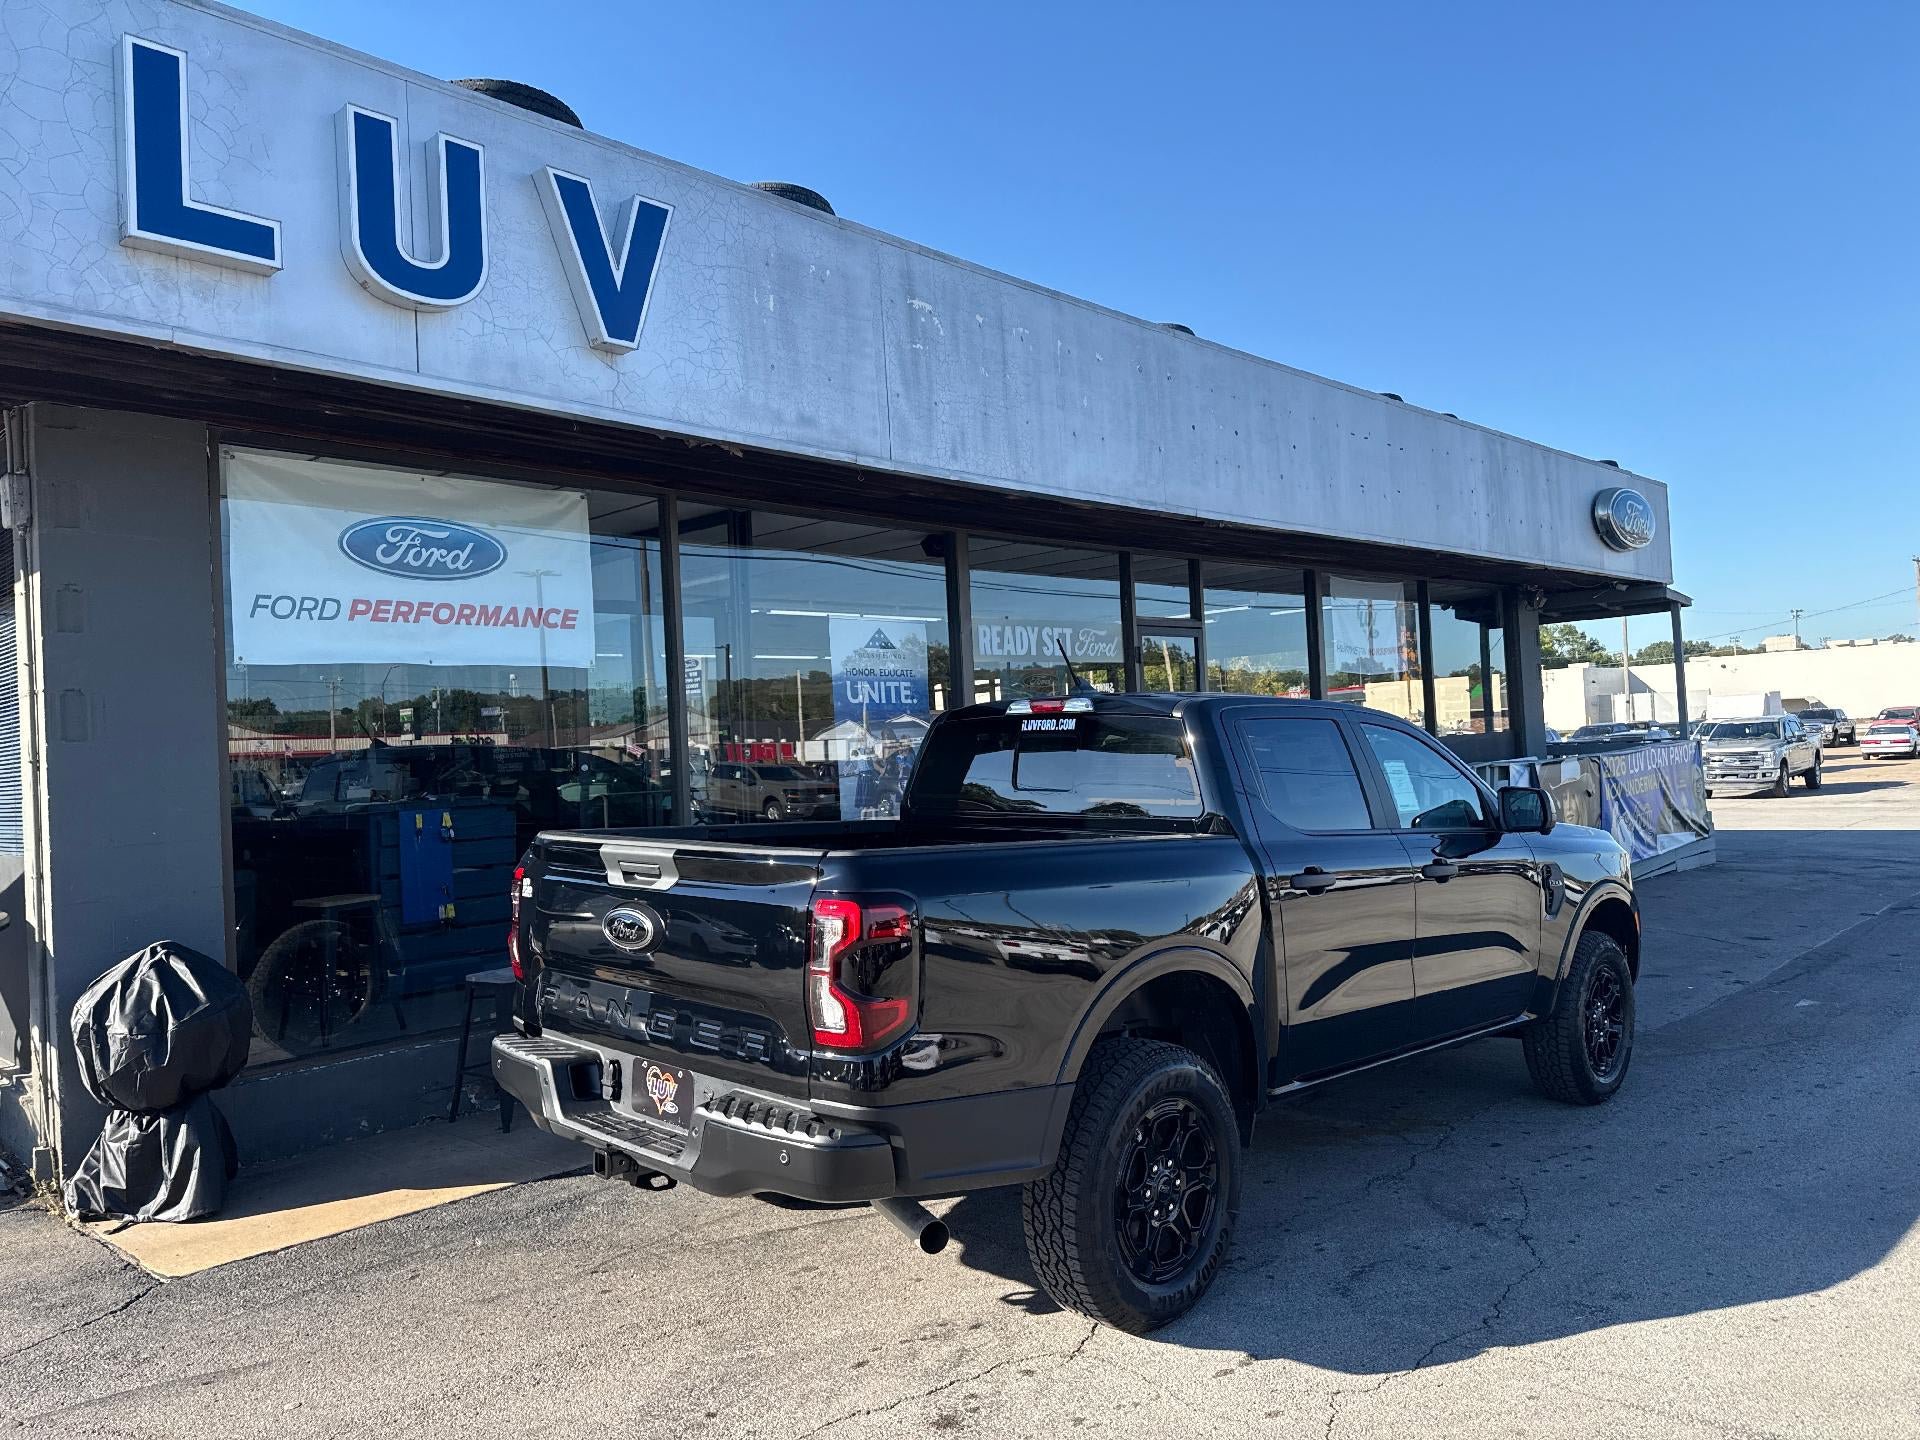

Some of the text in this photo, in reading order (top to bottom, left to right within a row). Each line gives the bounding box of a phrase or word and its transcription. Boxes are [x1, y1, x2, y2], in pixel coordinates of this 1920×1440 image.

[116, 32, 675, 354] LUV
[1624, 500, 1650, 536] Ford
[375, 525, 474, 571] Ford
[249, 594, 579, 630] FORD PERFORMANCE
[977, 624, 1119, 657] READY SET Ford
[845, 667, 916, 678] HONOR. EDUCATE.
[845, 680, 918, 704] UNITE.
[1628, 750, 1645, 774] LUV
[1646, 747, 1668, 770] LOAN
[611, 917, 639, 940] Ford
[539, 984, 773, 1063] RANGER
[649, 1077, 679, 1100] LUV
